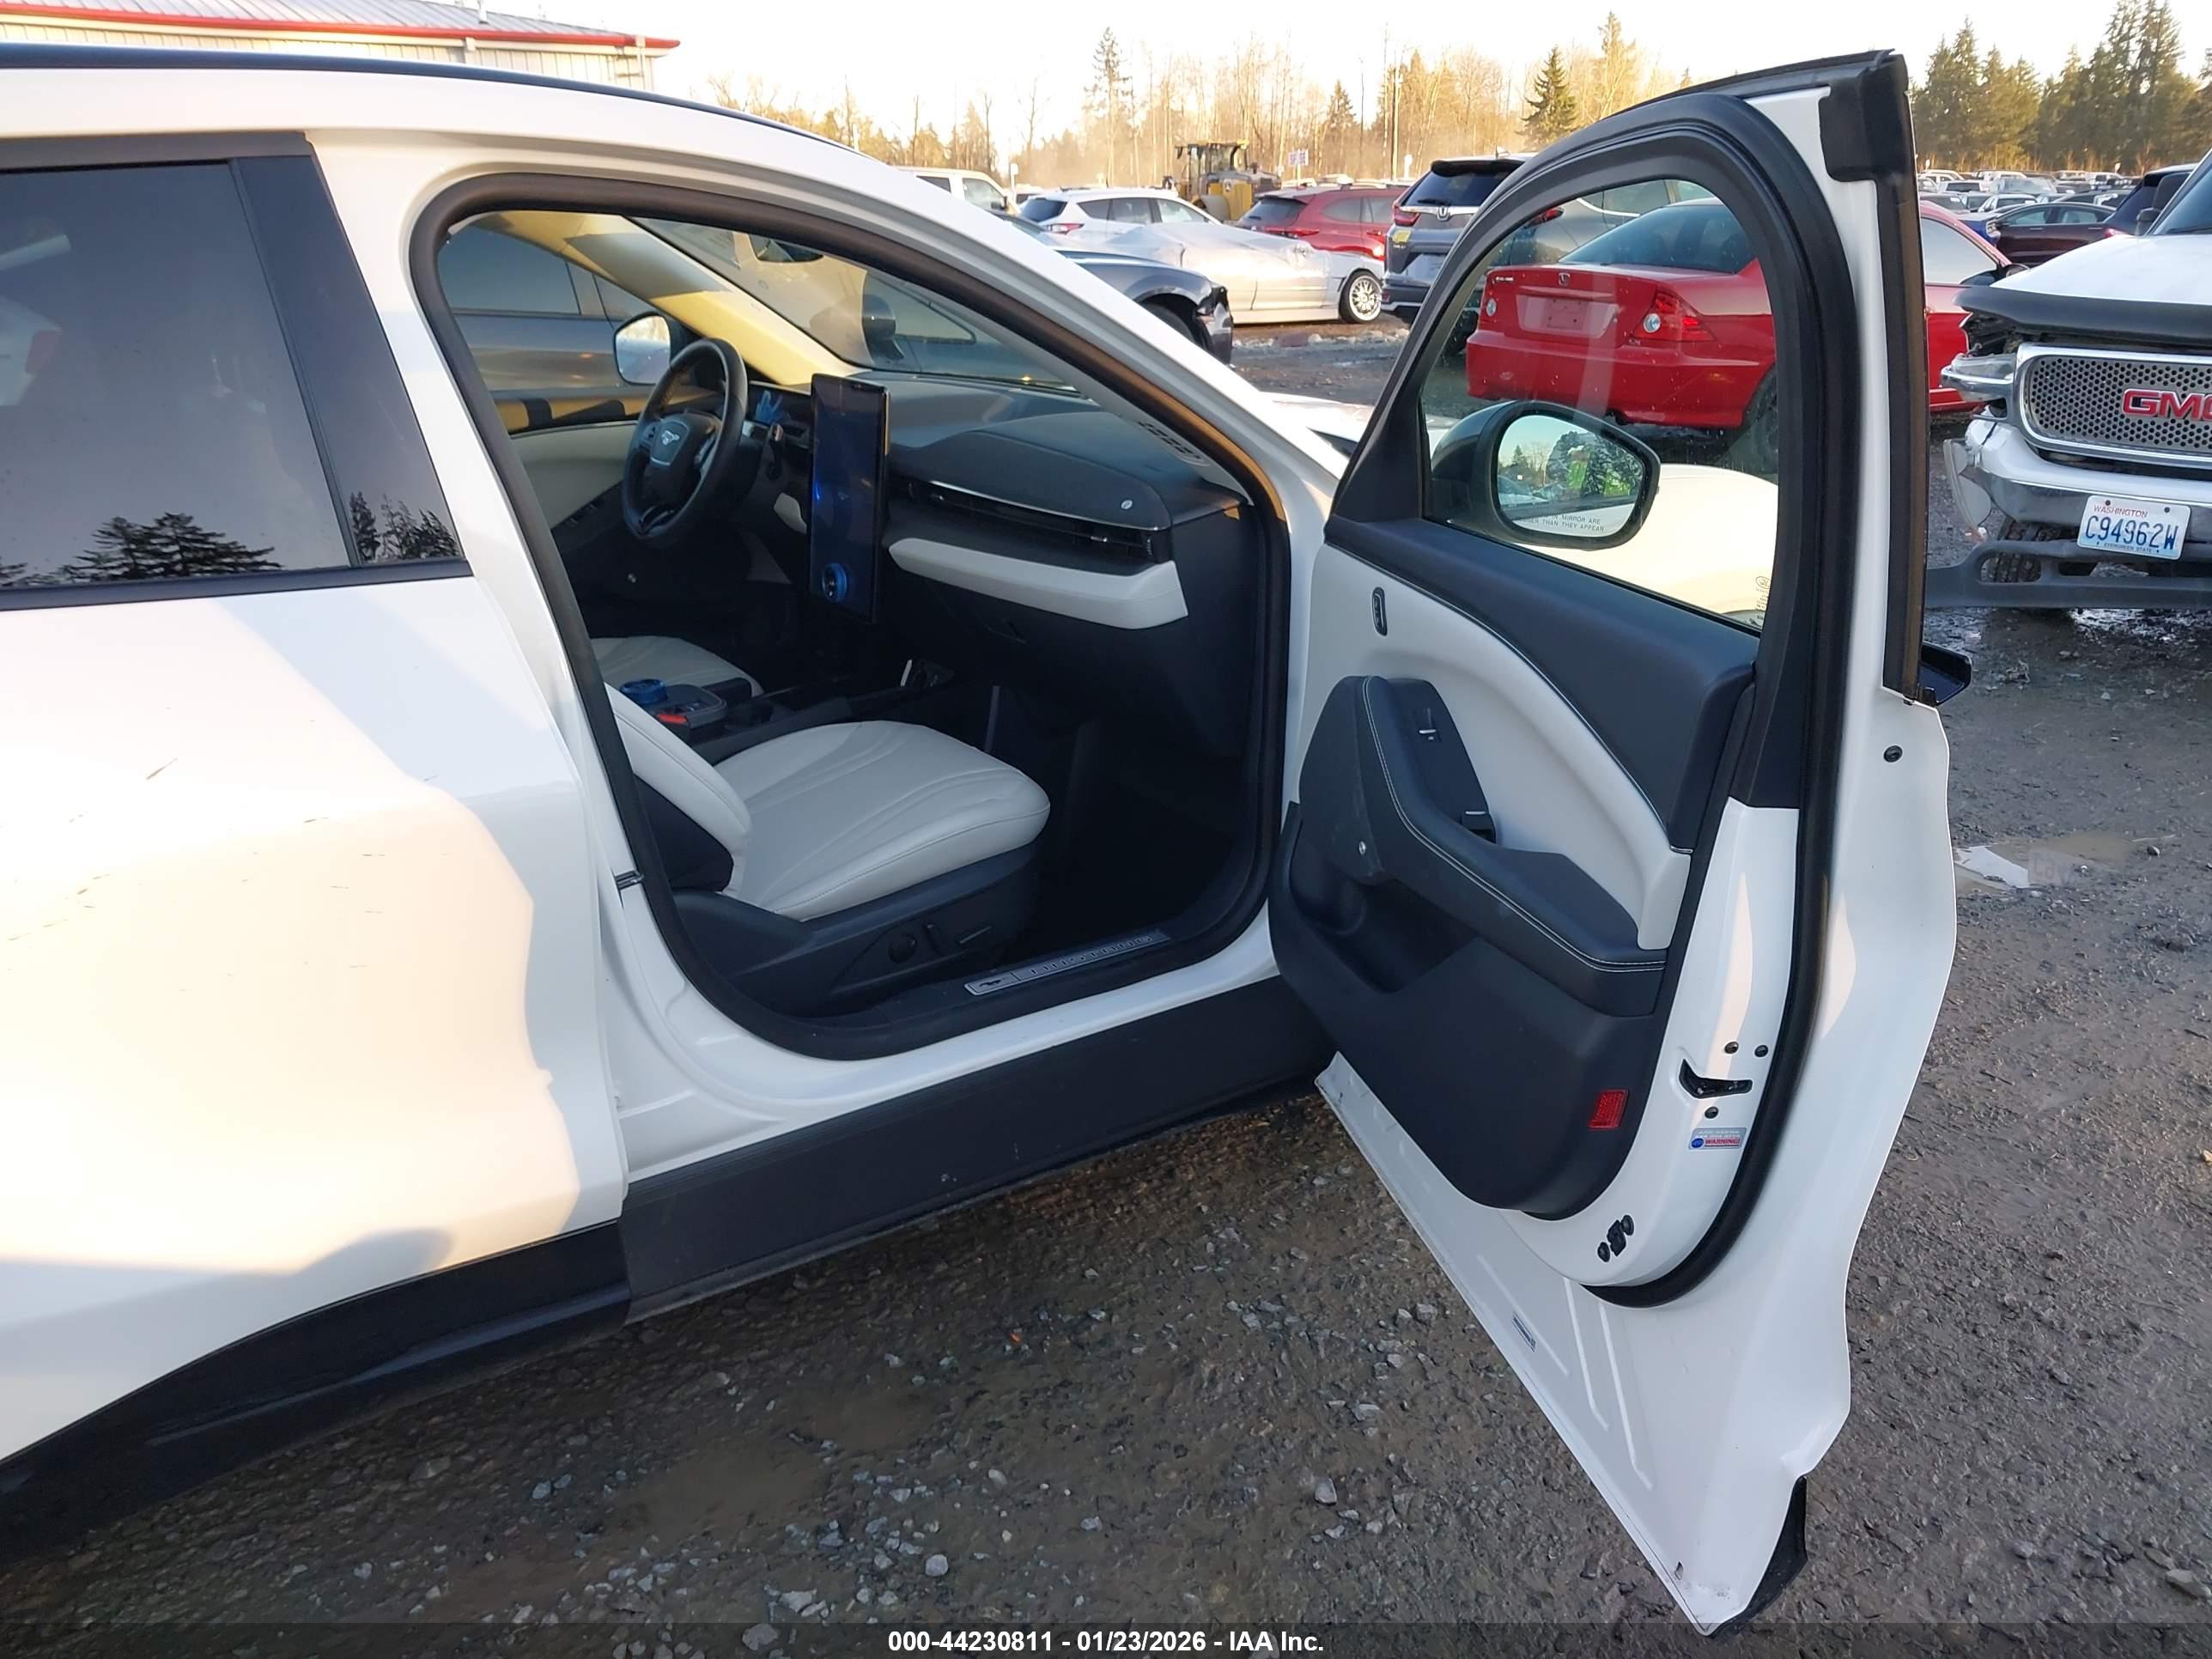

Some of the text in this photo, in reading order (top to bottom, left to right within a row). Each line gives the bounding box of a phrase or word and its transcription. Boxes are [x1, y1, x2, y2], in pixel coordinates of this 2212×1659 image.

[2122, 387, 2212, 422] GM
[2094, 504, 2148, 519] WASHINGTON
[1580, 524, 1605, 532] APPEAR
[2085, 515, 2179, 550] C94962W
